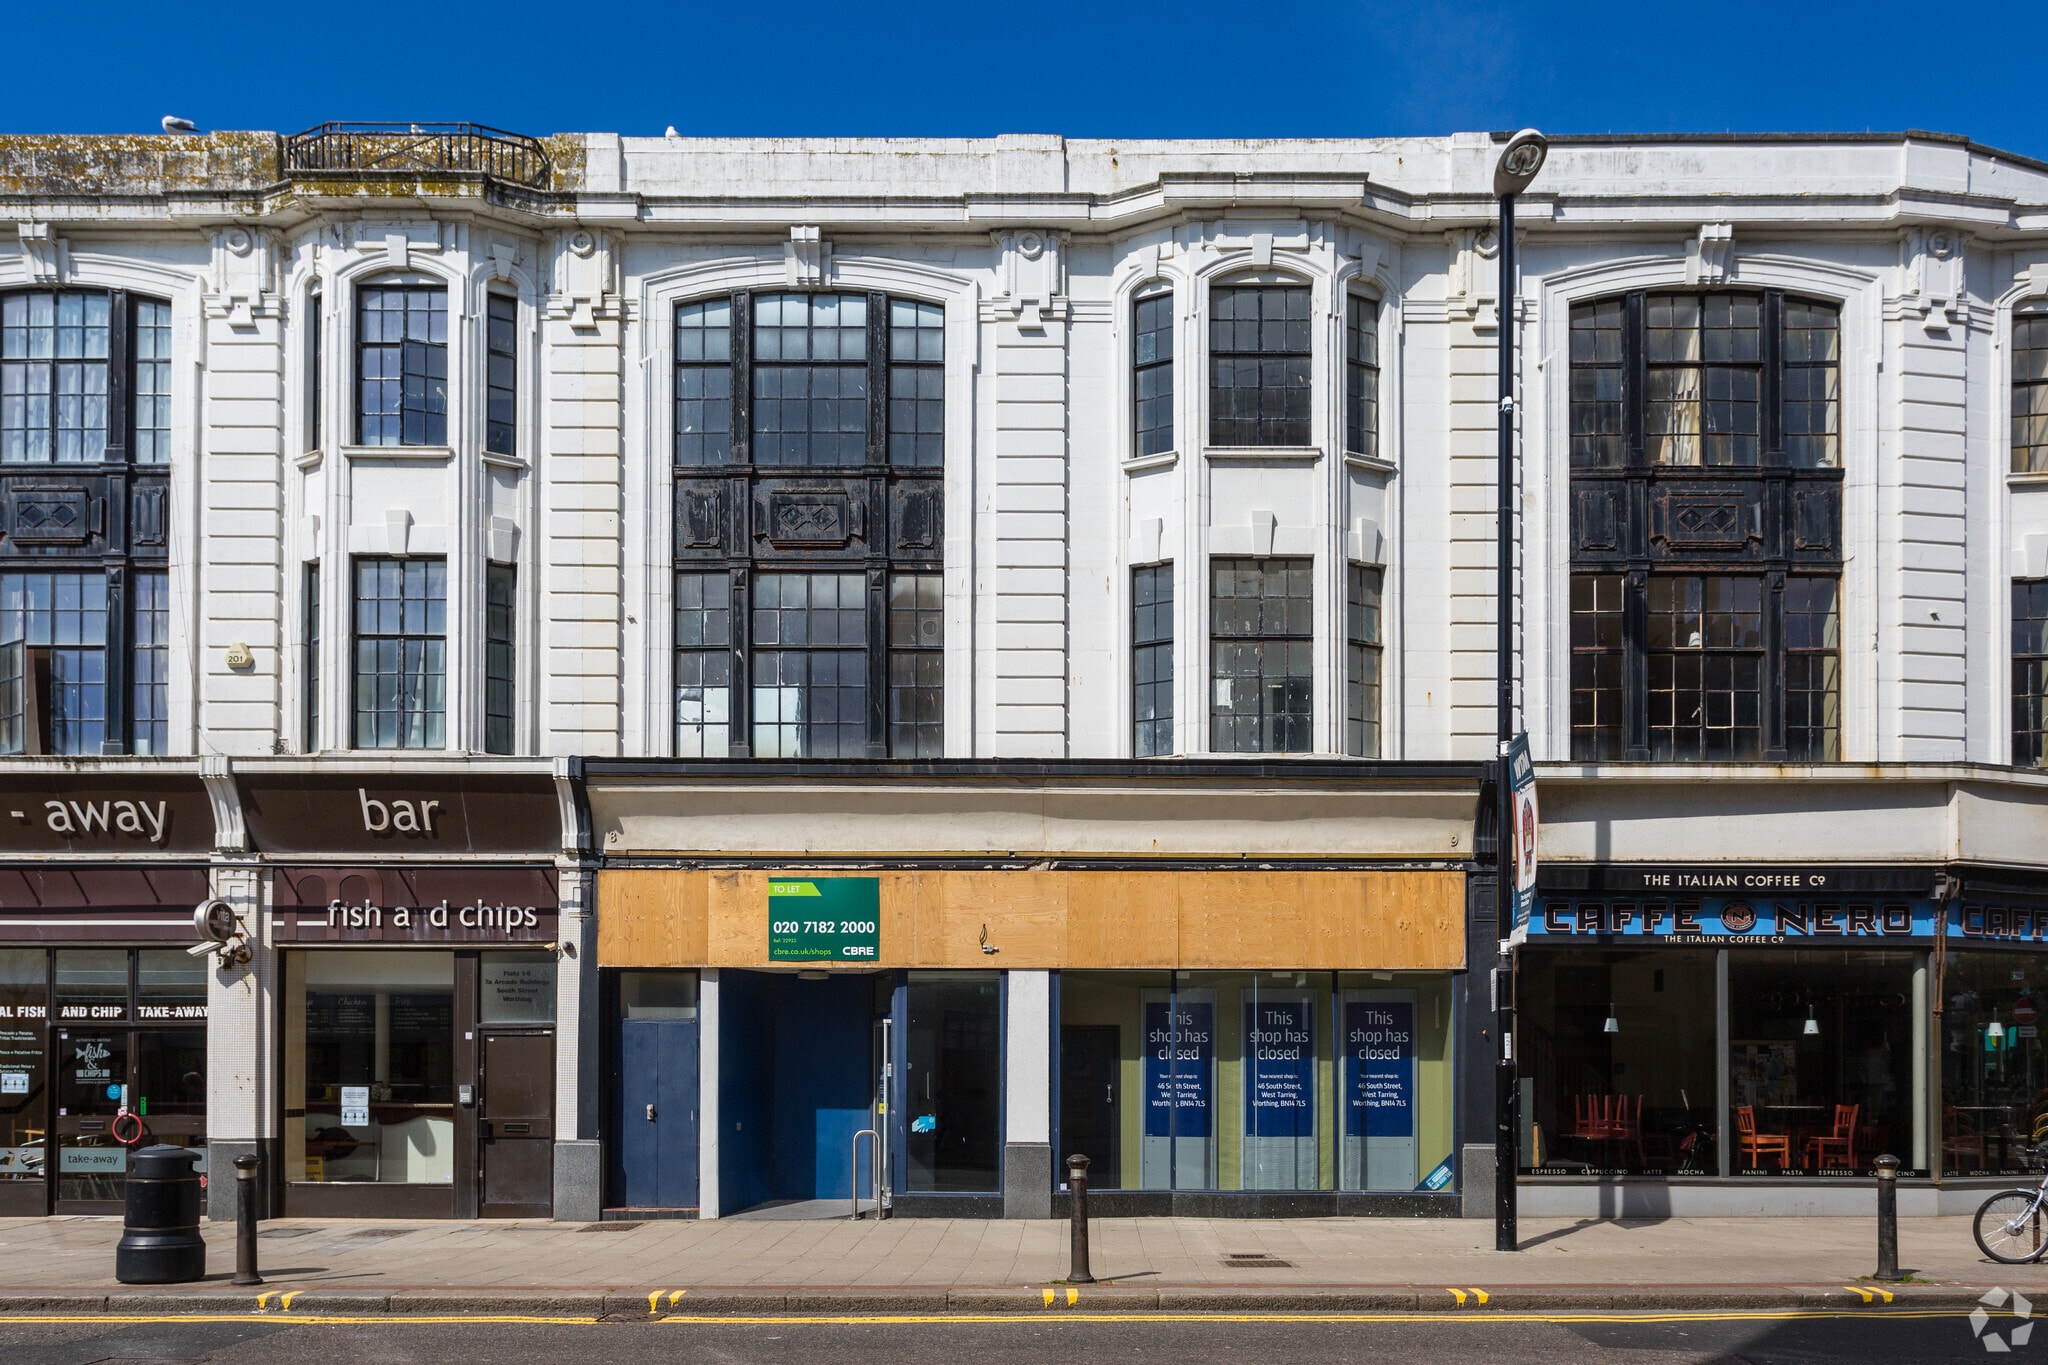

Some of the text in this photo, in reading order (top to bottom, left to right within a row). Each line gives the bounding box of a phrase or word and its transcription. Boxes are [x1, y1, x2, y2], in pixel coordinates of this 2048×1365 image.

[359, 788, 439, 831] bar
[45, 800, 166, 842] away
[1644, 874, 1670, 886] THE
[1678, 874, 1738, 886] ITALIAN
[1744, 875, 1800, 887] COFFEE
[328, 898, 381, 927] fish
[460, 898, 538, 934] chips
[1775, 904, 1912, 934] NERO
[773, 922, 875, 934] 020 7182 2000
[1664, 935, 1682, 943] THE
[1687, 935, 1724, 943] ITALIAN
[1730, 936, 1766, 944] COFFEE
[774, 948, 832, 956] cbre.co.uk/shops
[842, 946, 874, 956] CBRE
[18, 1006, 46, 1018] FISH
[62, 1006, 87, 1018] AND
[92, 1006, 122, 1018] CHIP
[138, 1006, 208, 1018] TAKE-AWAY
[1265, 1010, 1292, 1024] This
[1366, 1010, 1394, 1024] This
[1185, 1028, 1208, 1042] has
[1250, 1028, 1308, 1045] shop has
[1350, 1028, 1409, 1045] shop has
[85, 1043, 103, 1062] fish
[1258, 1046, 1300, 1060] closed
[1359, 1046, 1400, 1060] closed
[87, 1059, 98, 1070] &
[68, 1154, 118, 1165] take-away
